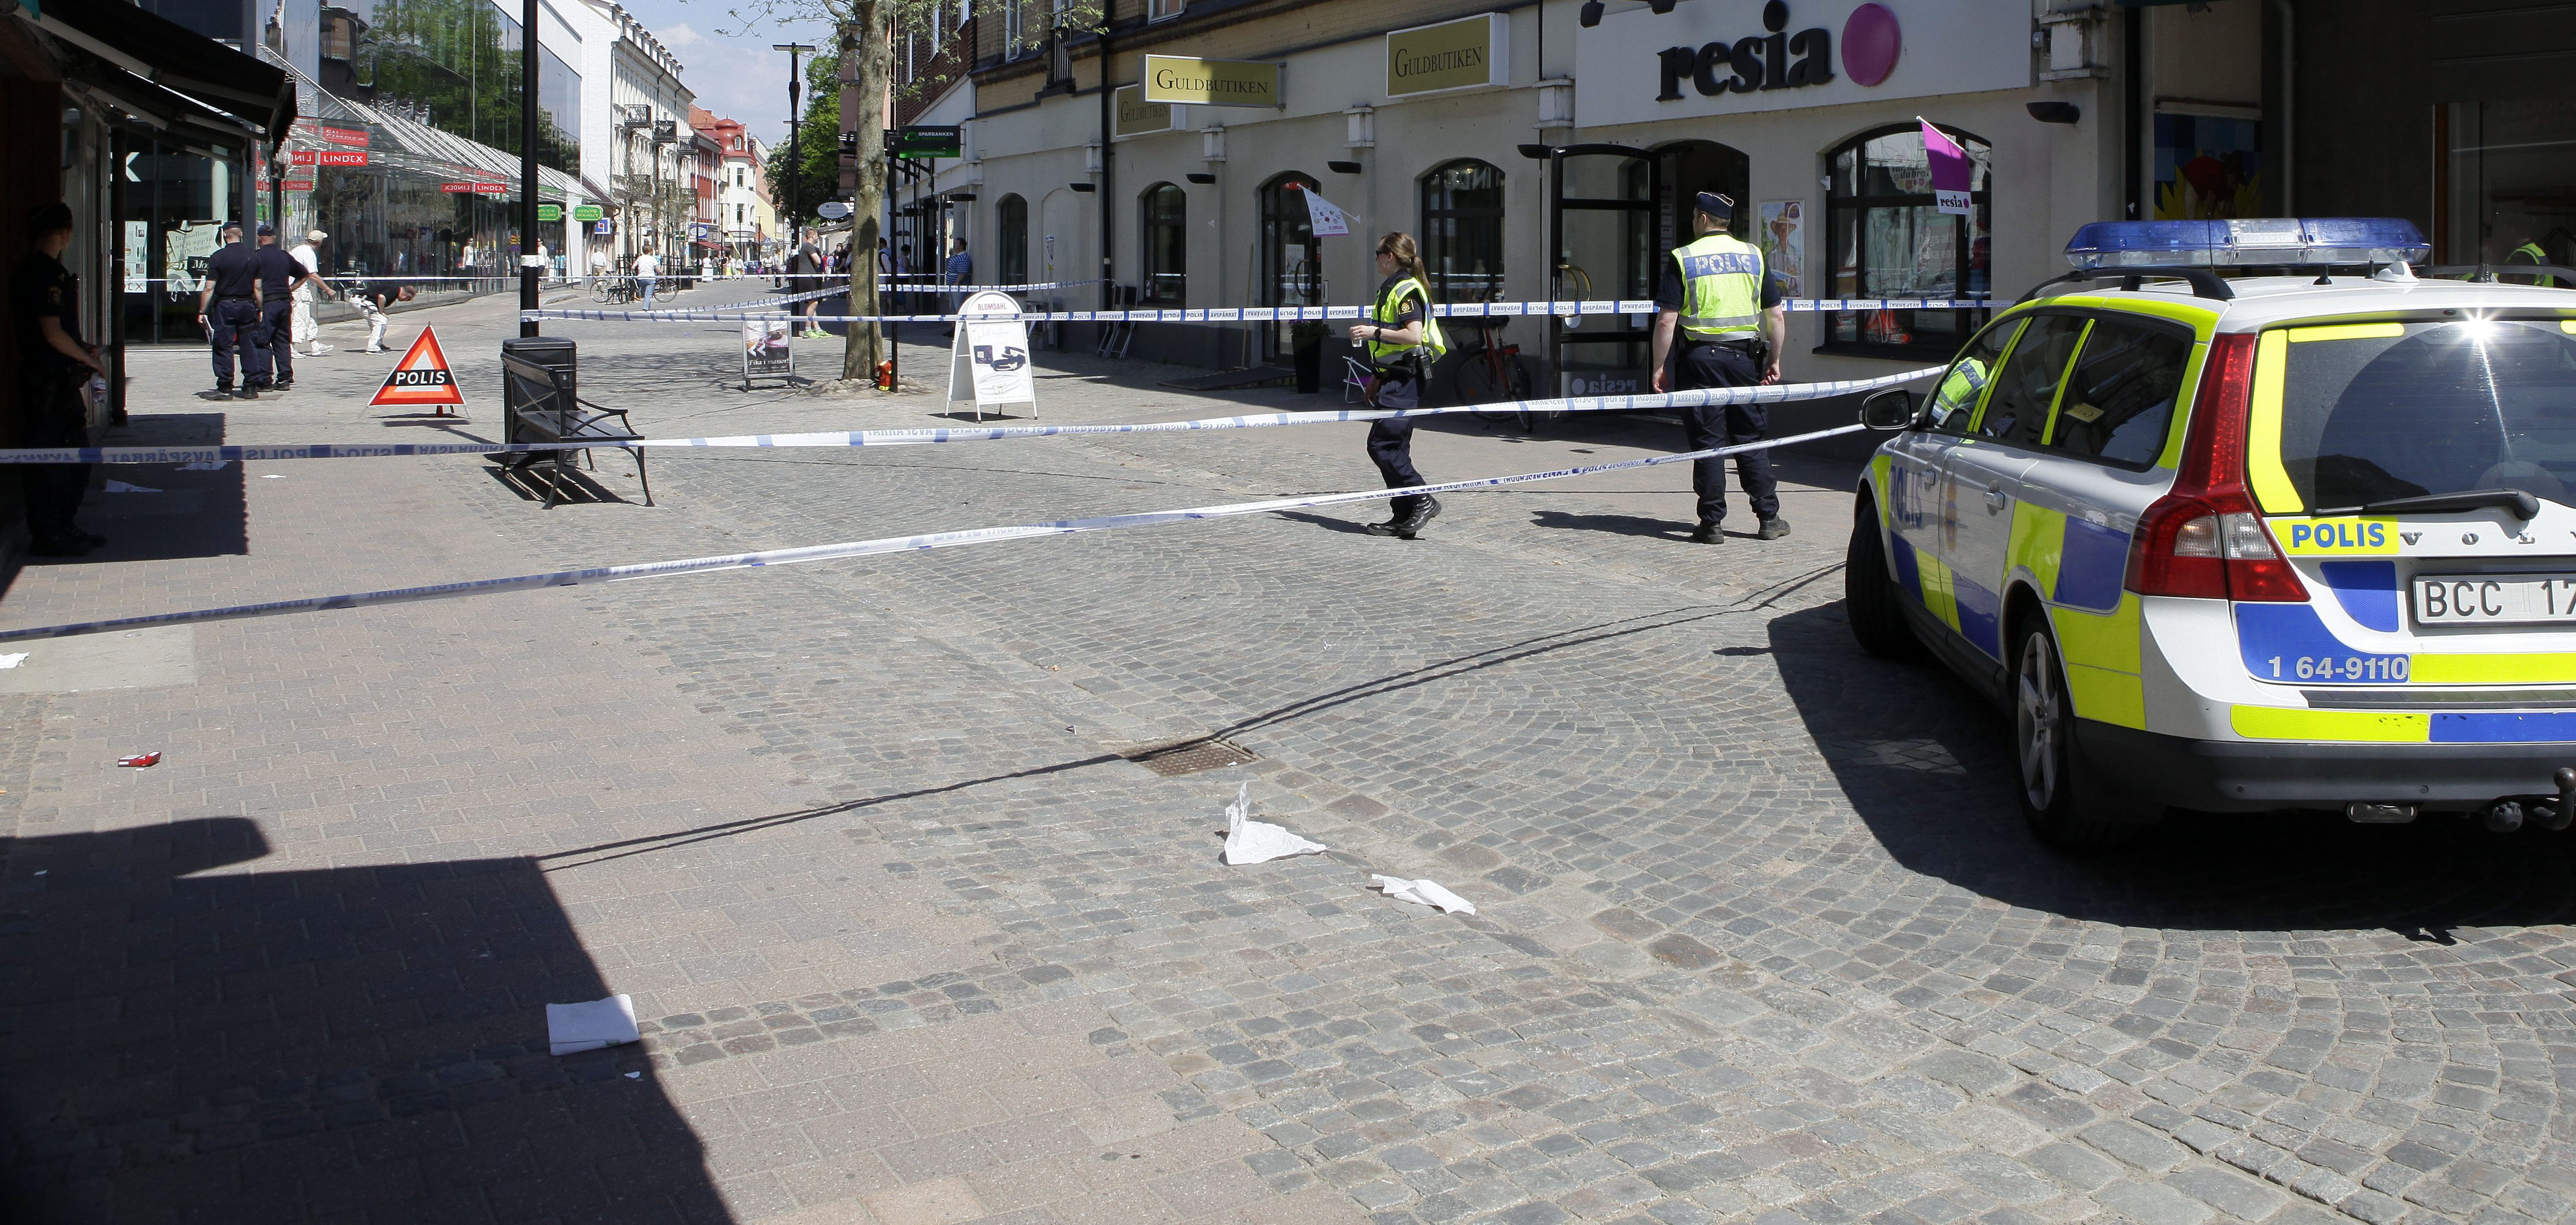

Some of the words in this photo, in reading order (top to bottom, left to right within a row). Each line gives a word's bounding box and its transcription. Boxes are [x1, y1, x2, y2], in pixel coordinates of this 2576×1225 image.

[1395, 46, 1482, 78] GULDBUTIKEN
[1655, 0, 1836, 102] resia
[1156, 69, 1268, 94] GULDBUTIKEN
[1121, 101, 1168, 122] GULDBUTIKEN
[324, 155, 363, 163] LINDEX
[1940, 195, 1963, 208] resia
[1694, 254, 1752, 275] POLIS
[396, 371, 446, 385] POLIS
[1890, 465, 1923, 531] POLIS
[2292, 523, 2385, 548] POLIS
[2425, 581, 2503, 617] BCC
[2268, 656, 2281, 677] 1
[2296, 656, 2408, 679] 64-9110
